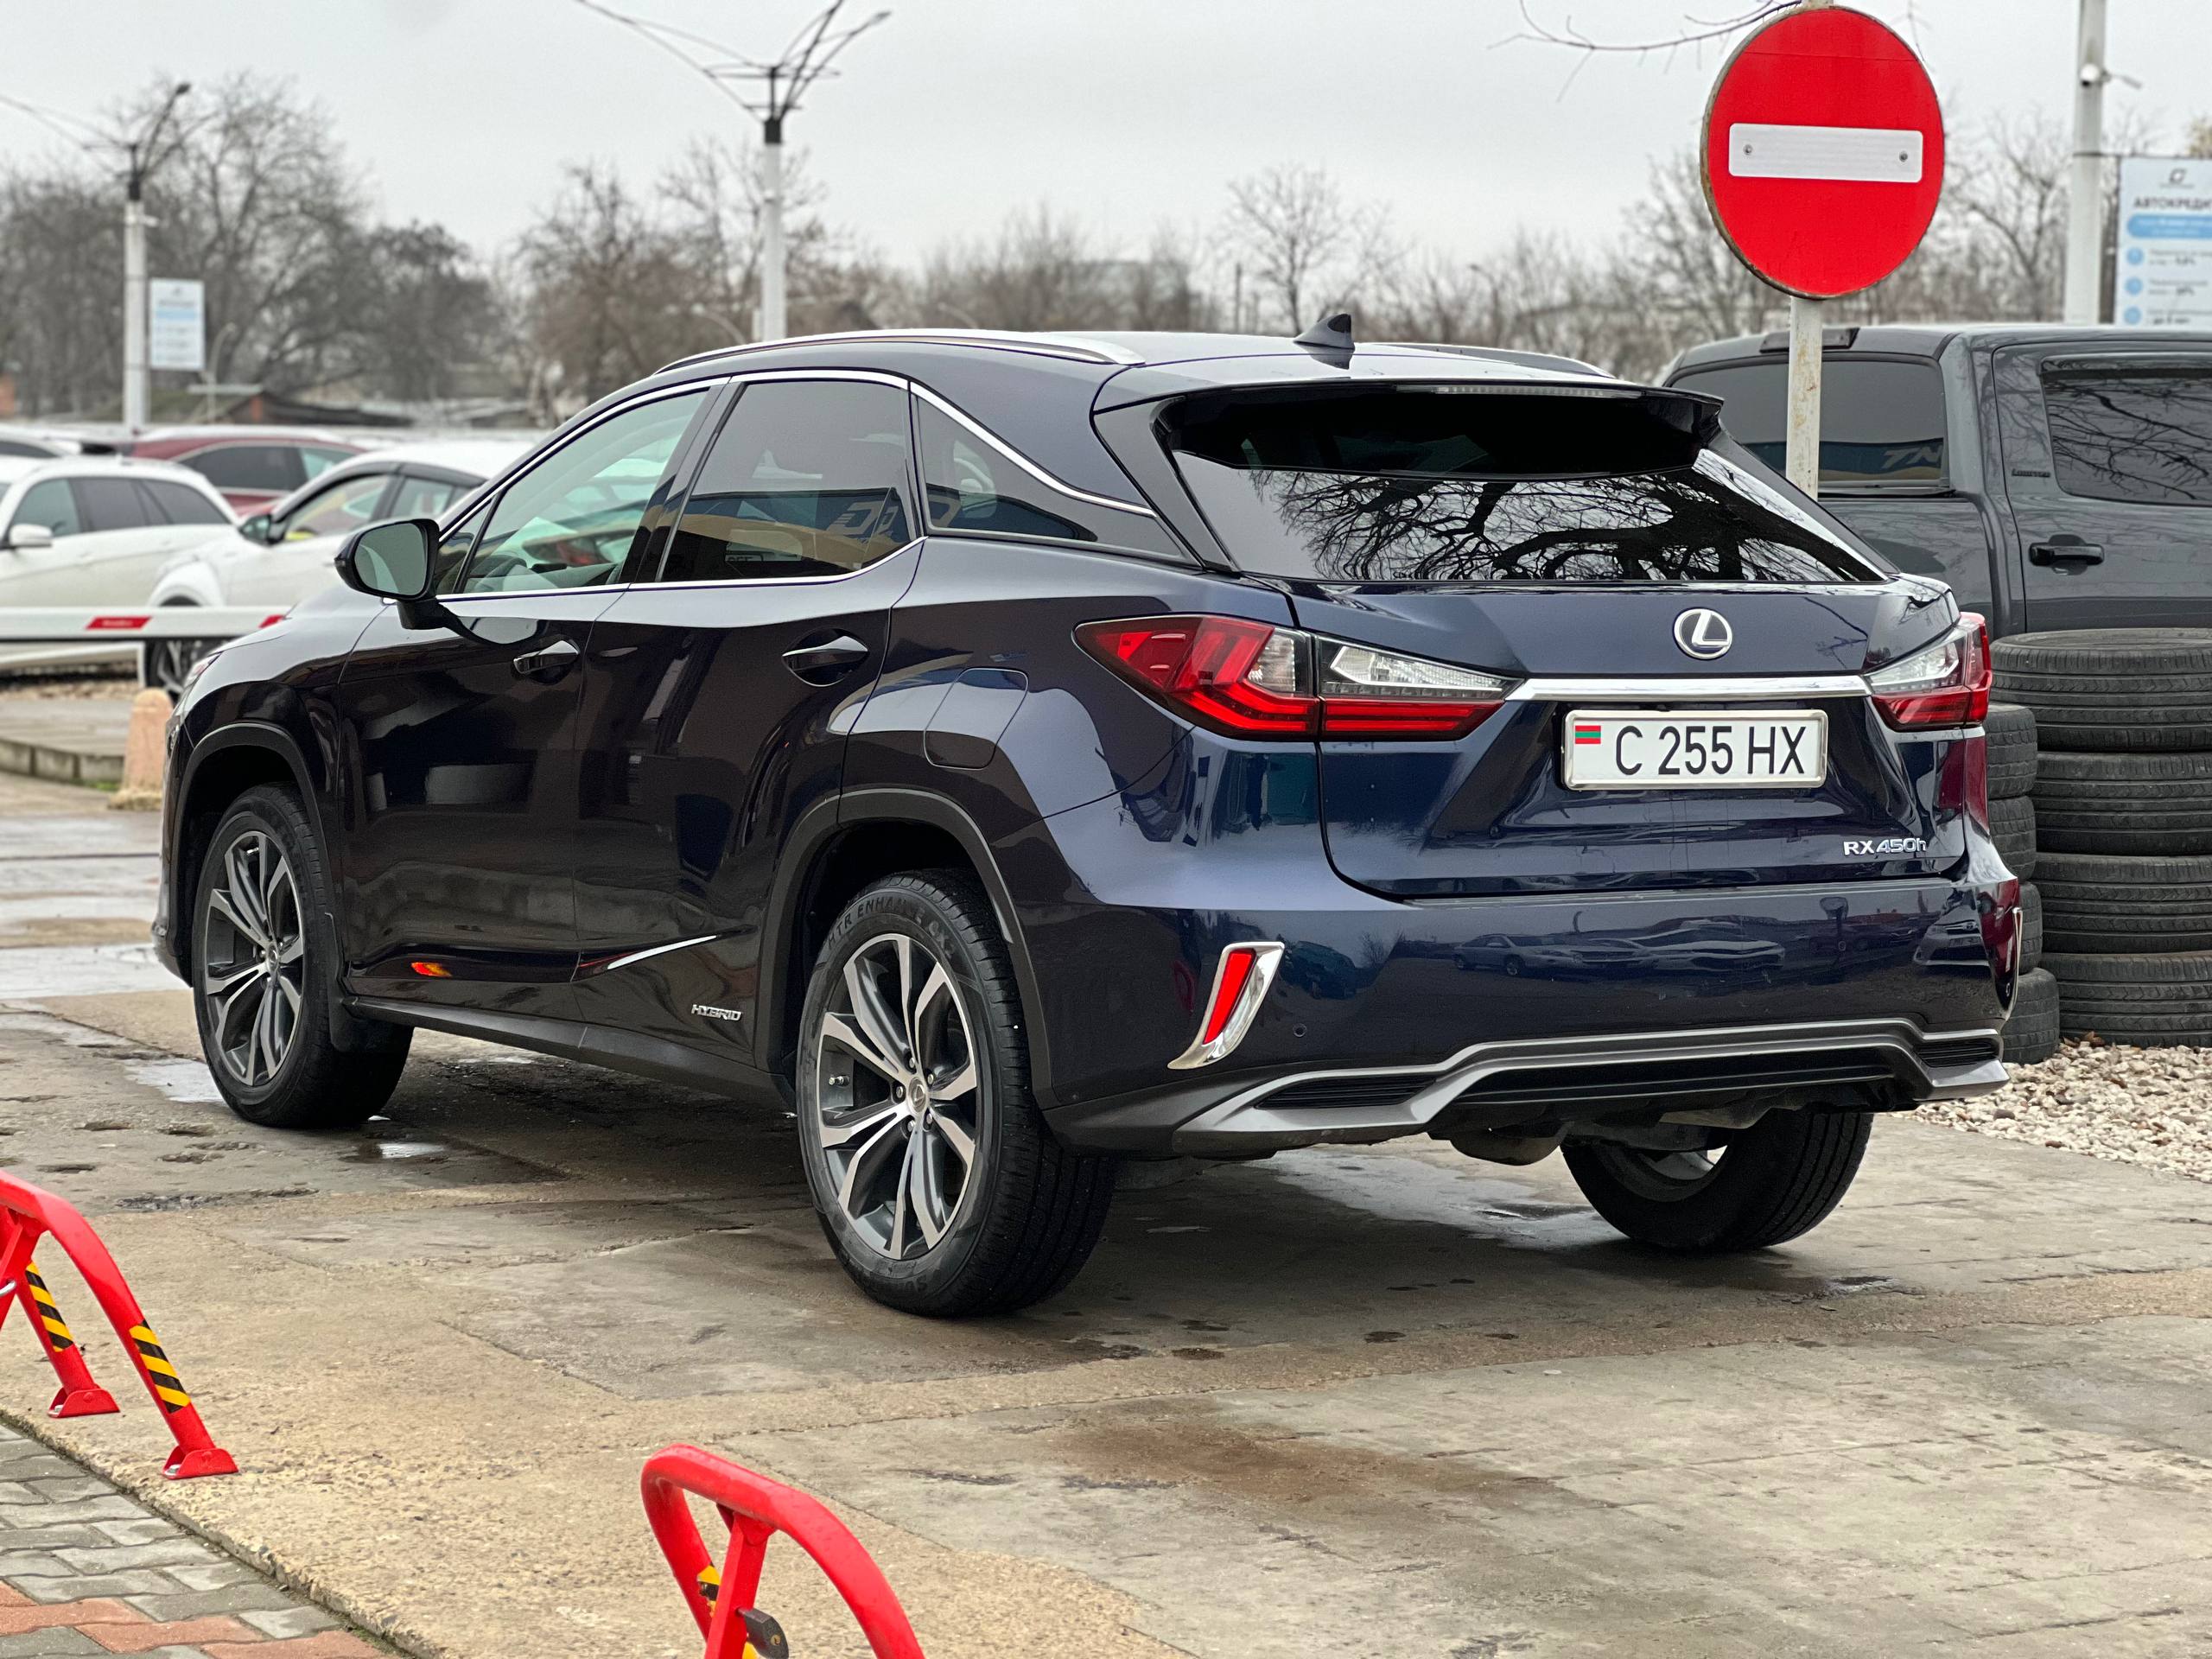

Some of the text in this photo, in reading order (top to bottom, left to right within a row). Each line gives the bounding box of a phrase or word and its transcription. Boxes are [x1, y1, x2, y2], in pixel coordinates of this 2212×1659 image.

[1616, 725, 1807, 776] C 255 HX
[691, 1004, 742, 1021] HYBRID
